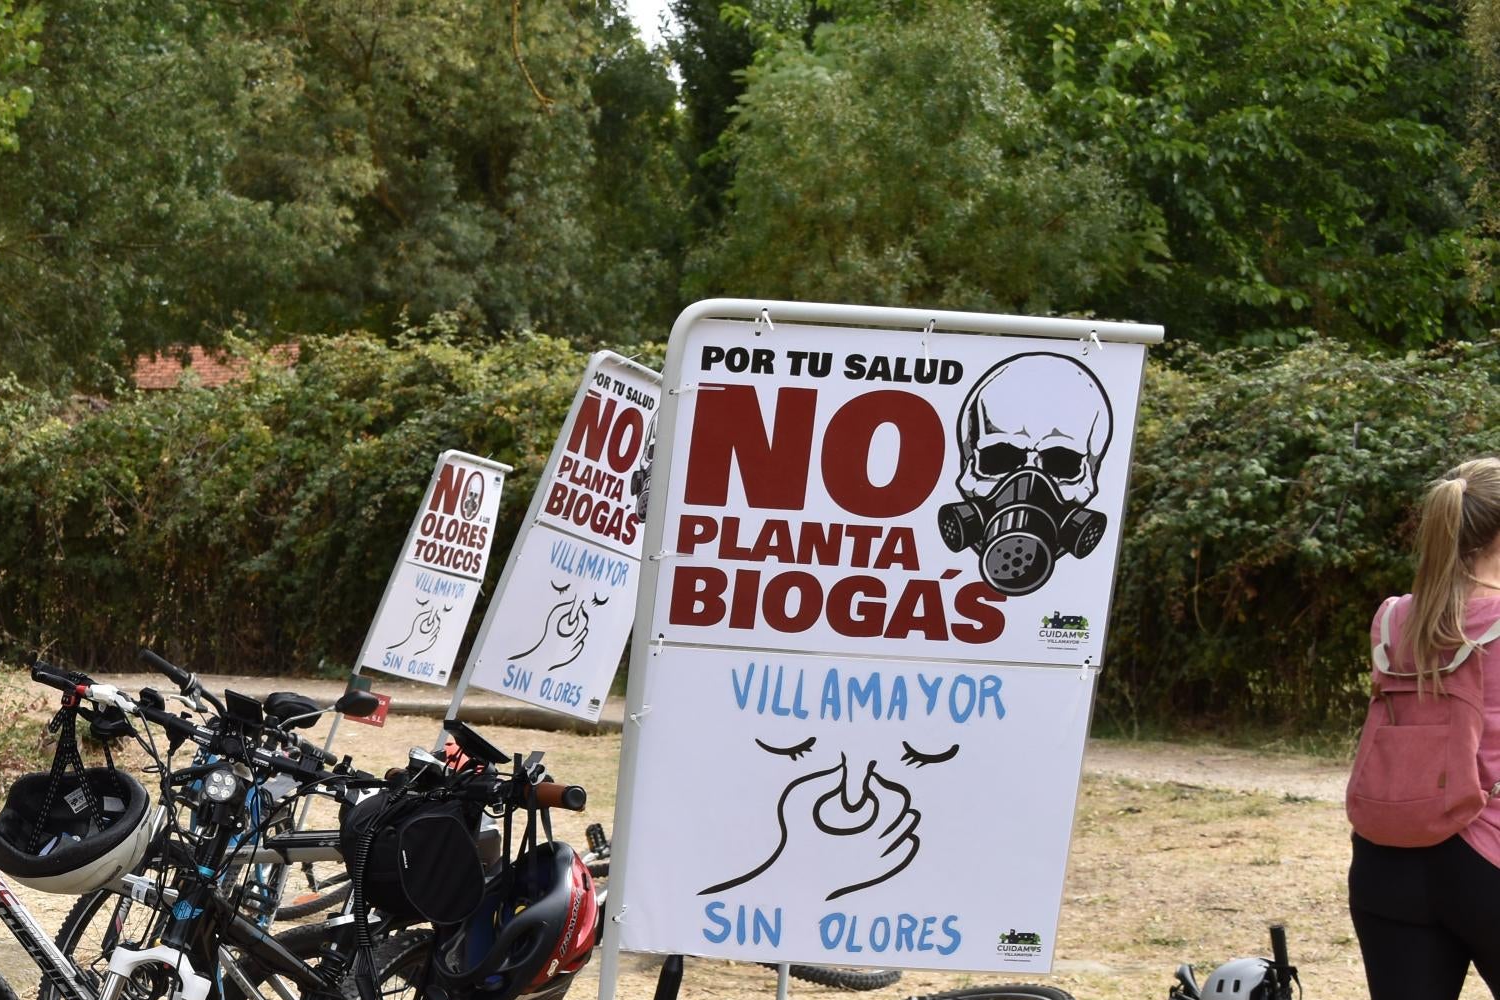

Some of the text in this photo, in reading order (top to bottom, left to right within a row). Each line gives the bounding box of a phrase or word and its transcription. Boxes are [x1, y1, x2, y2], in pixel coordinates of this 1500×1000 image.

[700, 345, 964, 386] POR TU SALUD
[614, 380, 625, 396] TU
[626, 386, 655, 411] SALUD
[566, 389, 644, 473] NO
[683, 381, 946, 519] NO
[428, 463, 485, 521] NO
[557, 455, 625, 503] PLANTA
[420, 512, 488, 550] OLORES
[544, 482, 641, 546] BIOGÁS
[551, 539, 630, 588] VILLAMAYOR
[676, 514, 921, 572] PLANTA
[415, 572, 466, 599] VILLAMAYOR
[668, 565, 1008, 645] BIOGÁS
[382, 651, 436, 677] SIN OLORES
[503, 663, 583, 708] SIN OLORES
[732, 663, 1006, 724] VILLAMAYOR
[702, 900, 963, 955] SIN OLORES
